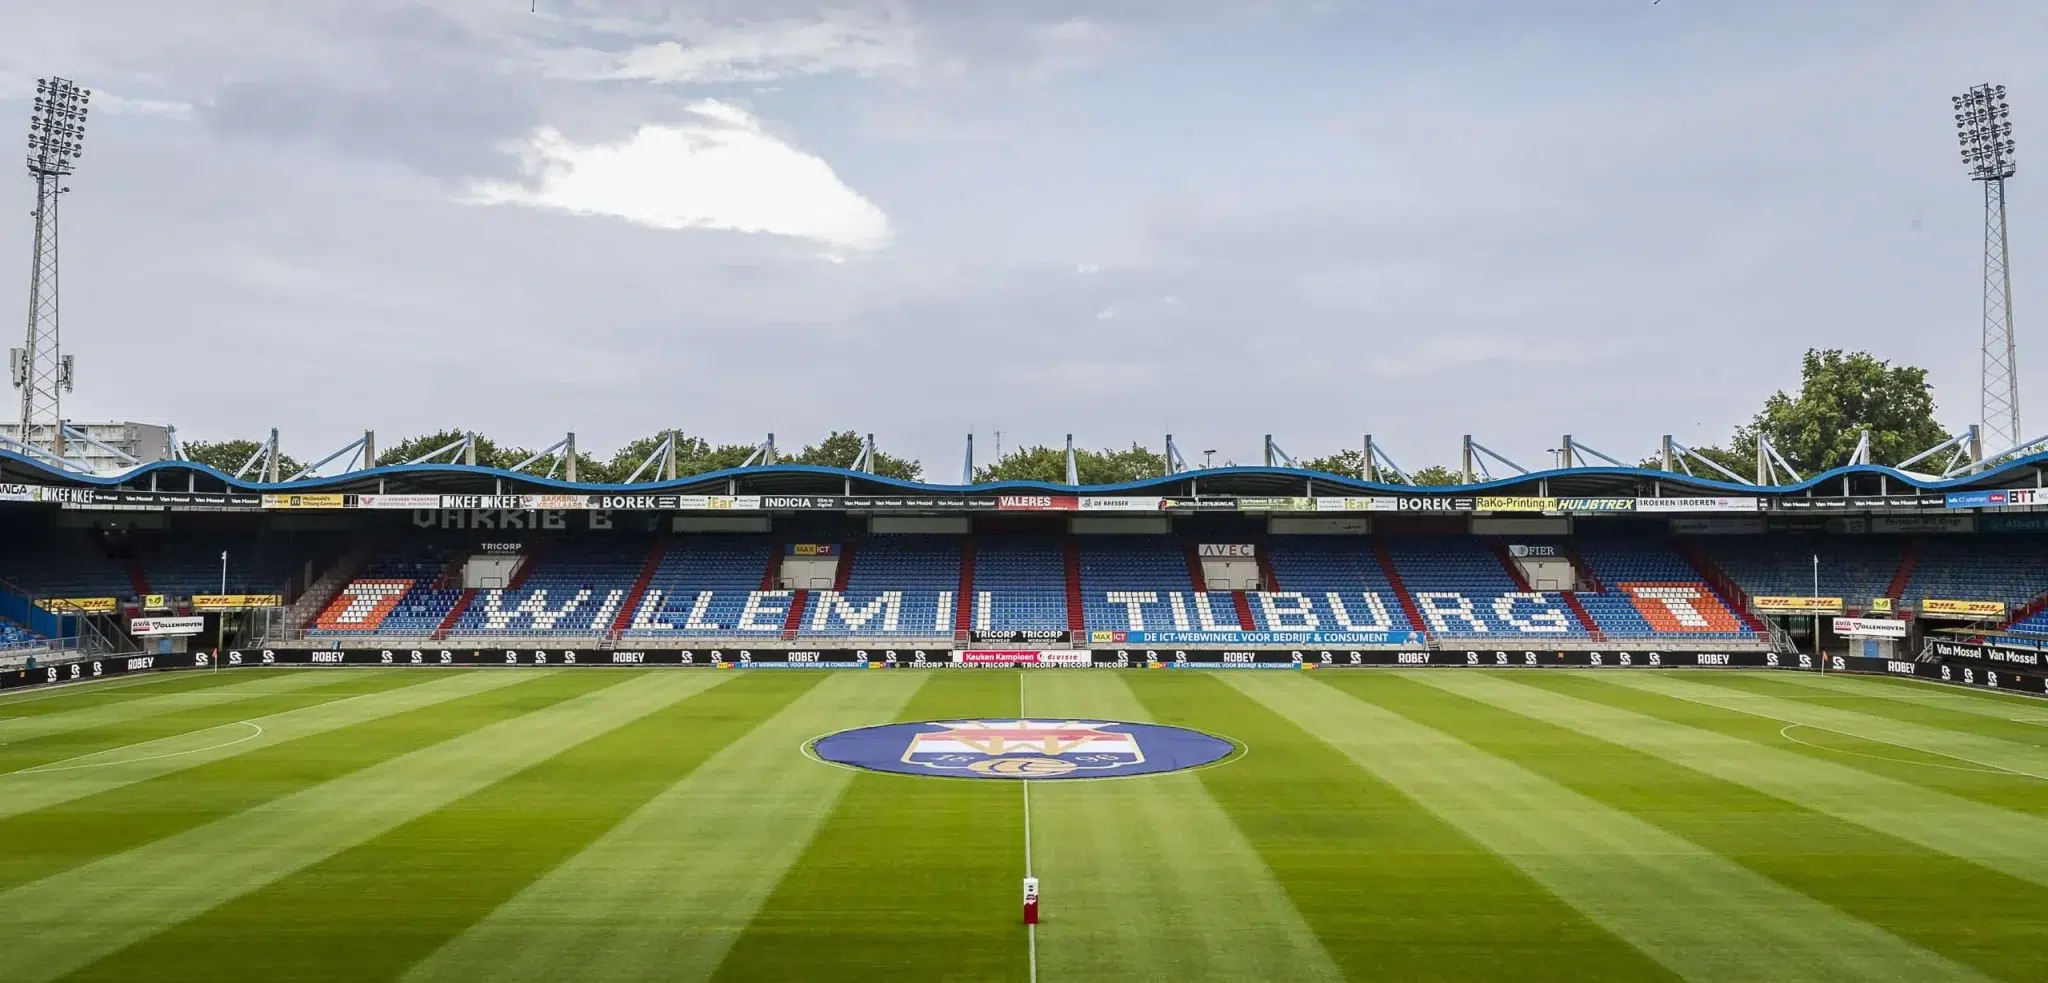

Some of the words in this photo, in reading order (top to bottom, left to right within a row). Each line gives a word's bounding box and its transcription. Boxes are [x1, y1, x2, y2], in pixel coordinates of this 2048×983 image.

[0, 485, 27, 494] NGA
[602, 496, 656, 508] BOREK
[1001, 496, 1051, 506] VALERES
[2009, 490, 2036, 503] BTT
[765, 498, 812, 508] INDICIA
[1400, 498, 1452, 510] BOREK
[1477, 498, 1556, 509] RaKo-Printing.nl
[1558, 500, 1634, 510] HUIJBTREX
[1204, 544, 1250, 555] AVEC
[1529, 546, 1554, 556] FIER
[484, 590, 901, 631] WILLEM
[1107, 592, 1568, 632] TILBURG
[152, 622, 202, 630] VOLLENHOVEN
[1853, 622, 1904, 631] VOLLENHOVEN
[1144, 632, 1157, 641] DE
[1160, 632, 1238, 641] ICT-WEBWINKEL
[1242, 632, 1270, 642] VOOR
[1273, 632, 1311, 643] BEDRIJF
[1314, 633, 1322, 642] &
[1324, 633, 1388, 642] CONSUMENT
[312, 651, 344, 662] ROBEY
[613, 652, 645, 662] ROBEY
[788, 652, 820, 662] ROBEY
[996, 654, 1034, 662] Kampioen
[1224, 652, 1255, 662] ROBEY
[1398, 653, 1430, 664] ROBEY
[1698, 654, 1730, 665] ROBEY
[1936, 644, 1952, 655] Van
[1953, 646, 1982, 659] Mossel
[1988, 649, 2004, 661] Van
[2006, 651, 2038, 665] Mossel
[128, 657, 154, 670] ROBEY
[1888, 660, 1915, 674] ROBEY
